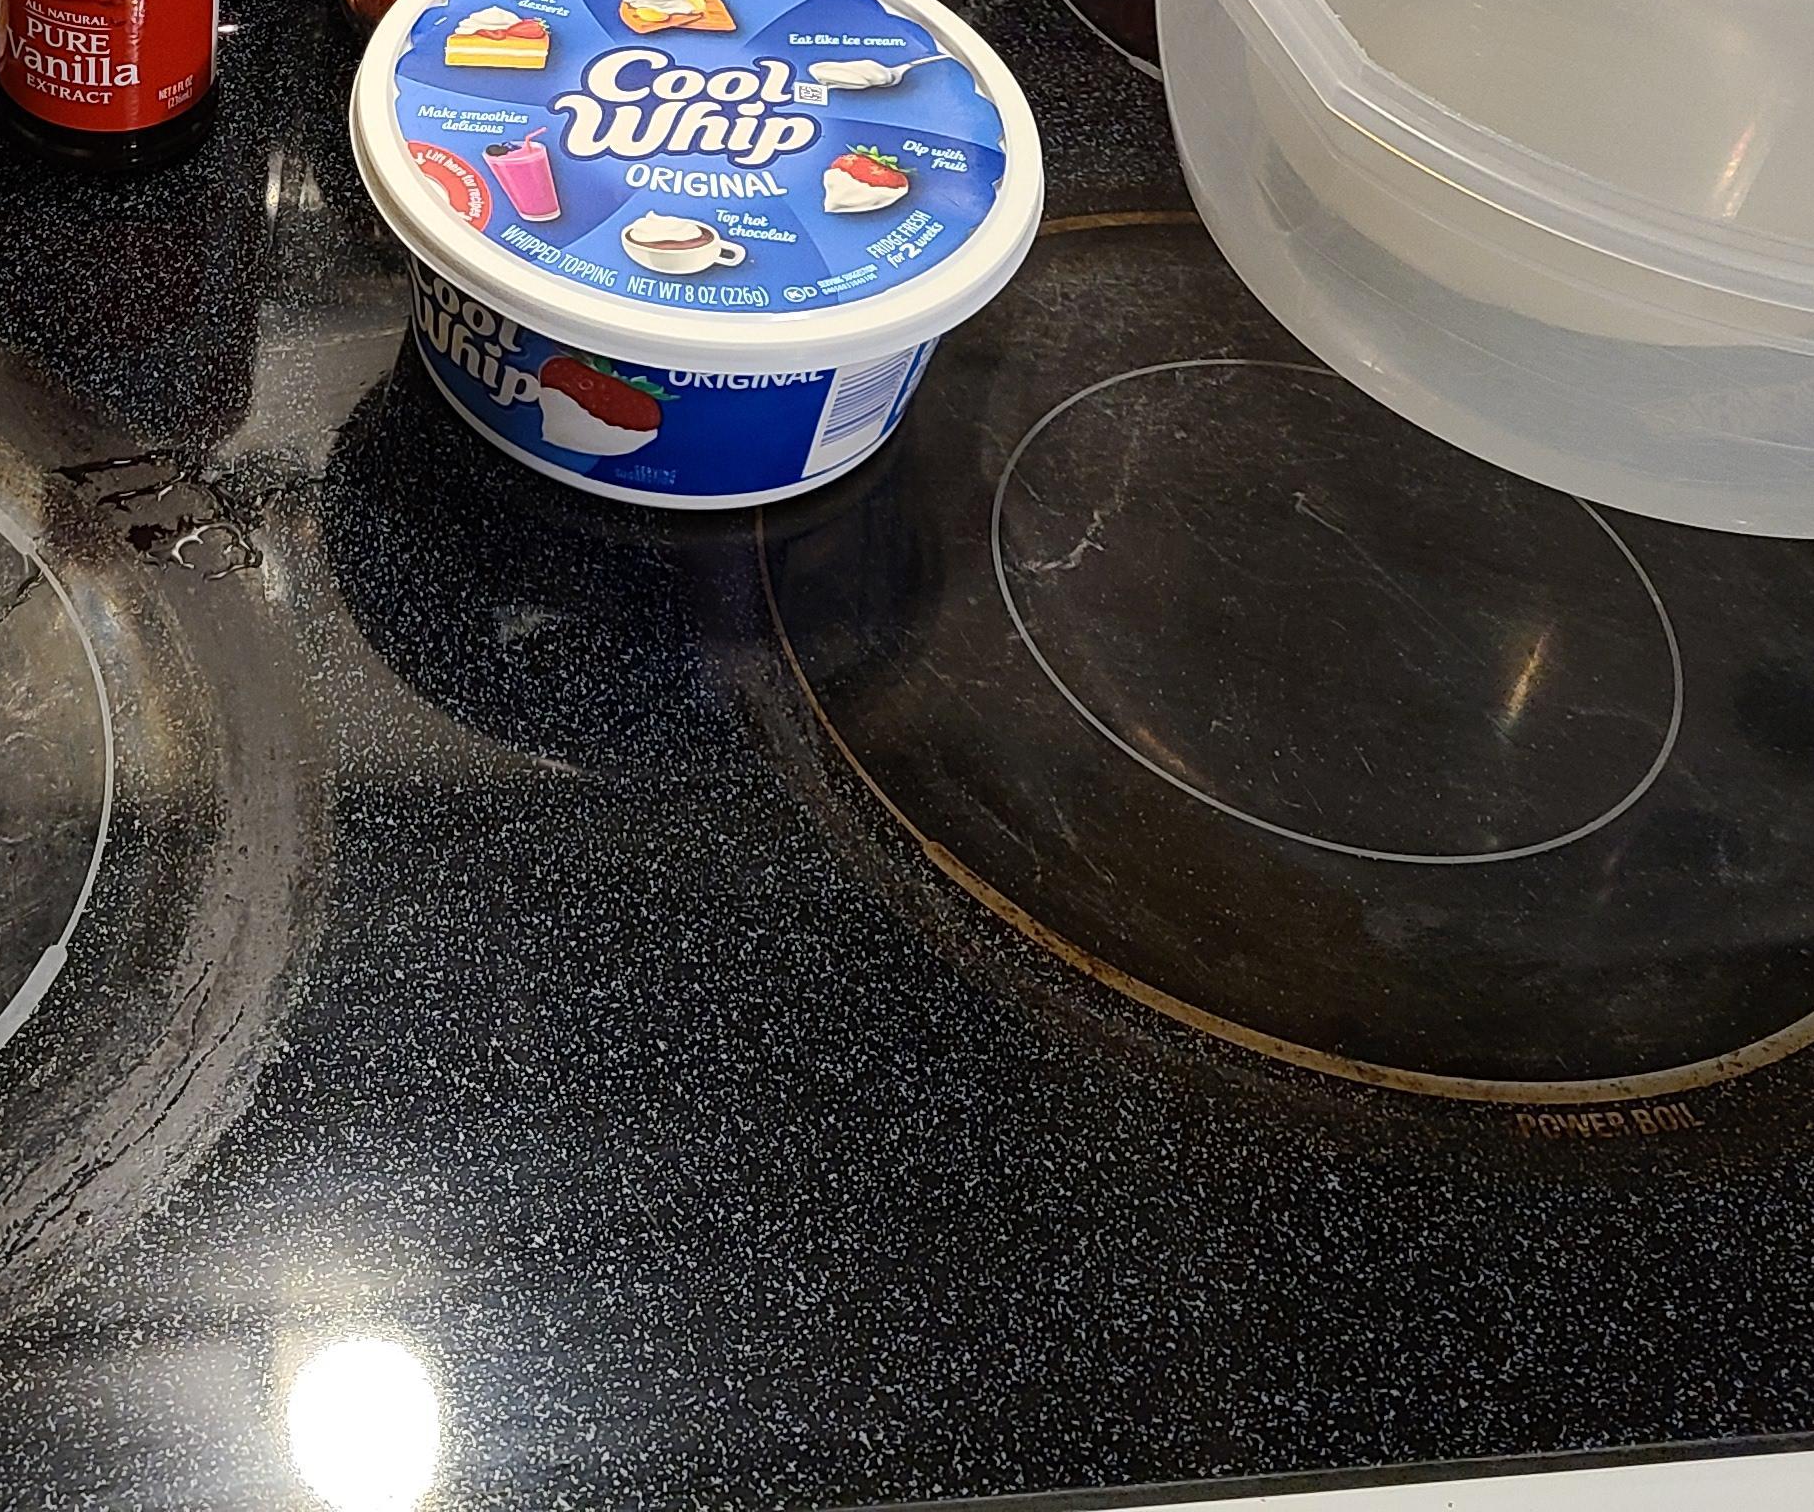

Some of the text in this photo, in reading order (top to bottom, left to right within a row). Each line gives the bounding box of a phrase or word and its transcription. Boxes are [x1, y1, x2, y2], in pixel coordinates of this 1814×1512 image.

[47, 6, 109, 27] NATURAL
[26, 14, 111, 55] PURE
[789, 33, 906, 47] Eat like ice cream
[6, 26, 141, 87] Vanilla
[26, 72, 113, 105] EXTRACT
[586, 48, 793, 104] Cool
[417, 104, 529, 125] Make smoothies
[441, 120, 504, 135] delicious
[553, 93, 816, 165] Whip
[902, 139, 966, 163] Dip with
[930, 156, 968, 173] fruit
[625, 163, 789, 198] ORIGINAL
[715, 208, 770, 227] Top hot
[728, 224, 798, 244] chocolate
[866, 209, 933, 259] FRIDGE FRESH
[500, 223, 618, 288] WHIPPED TOPPING
[886, 221, 945, 268] for 2 weeks
[626, 275, 770, 308] NET WT 8 OZ (226g)
[1630, 1101, 1706, 1135] BOIL
